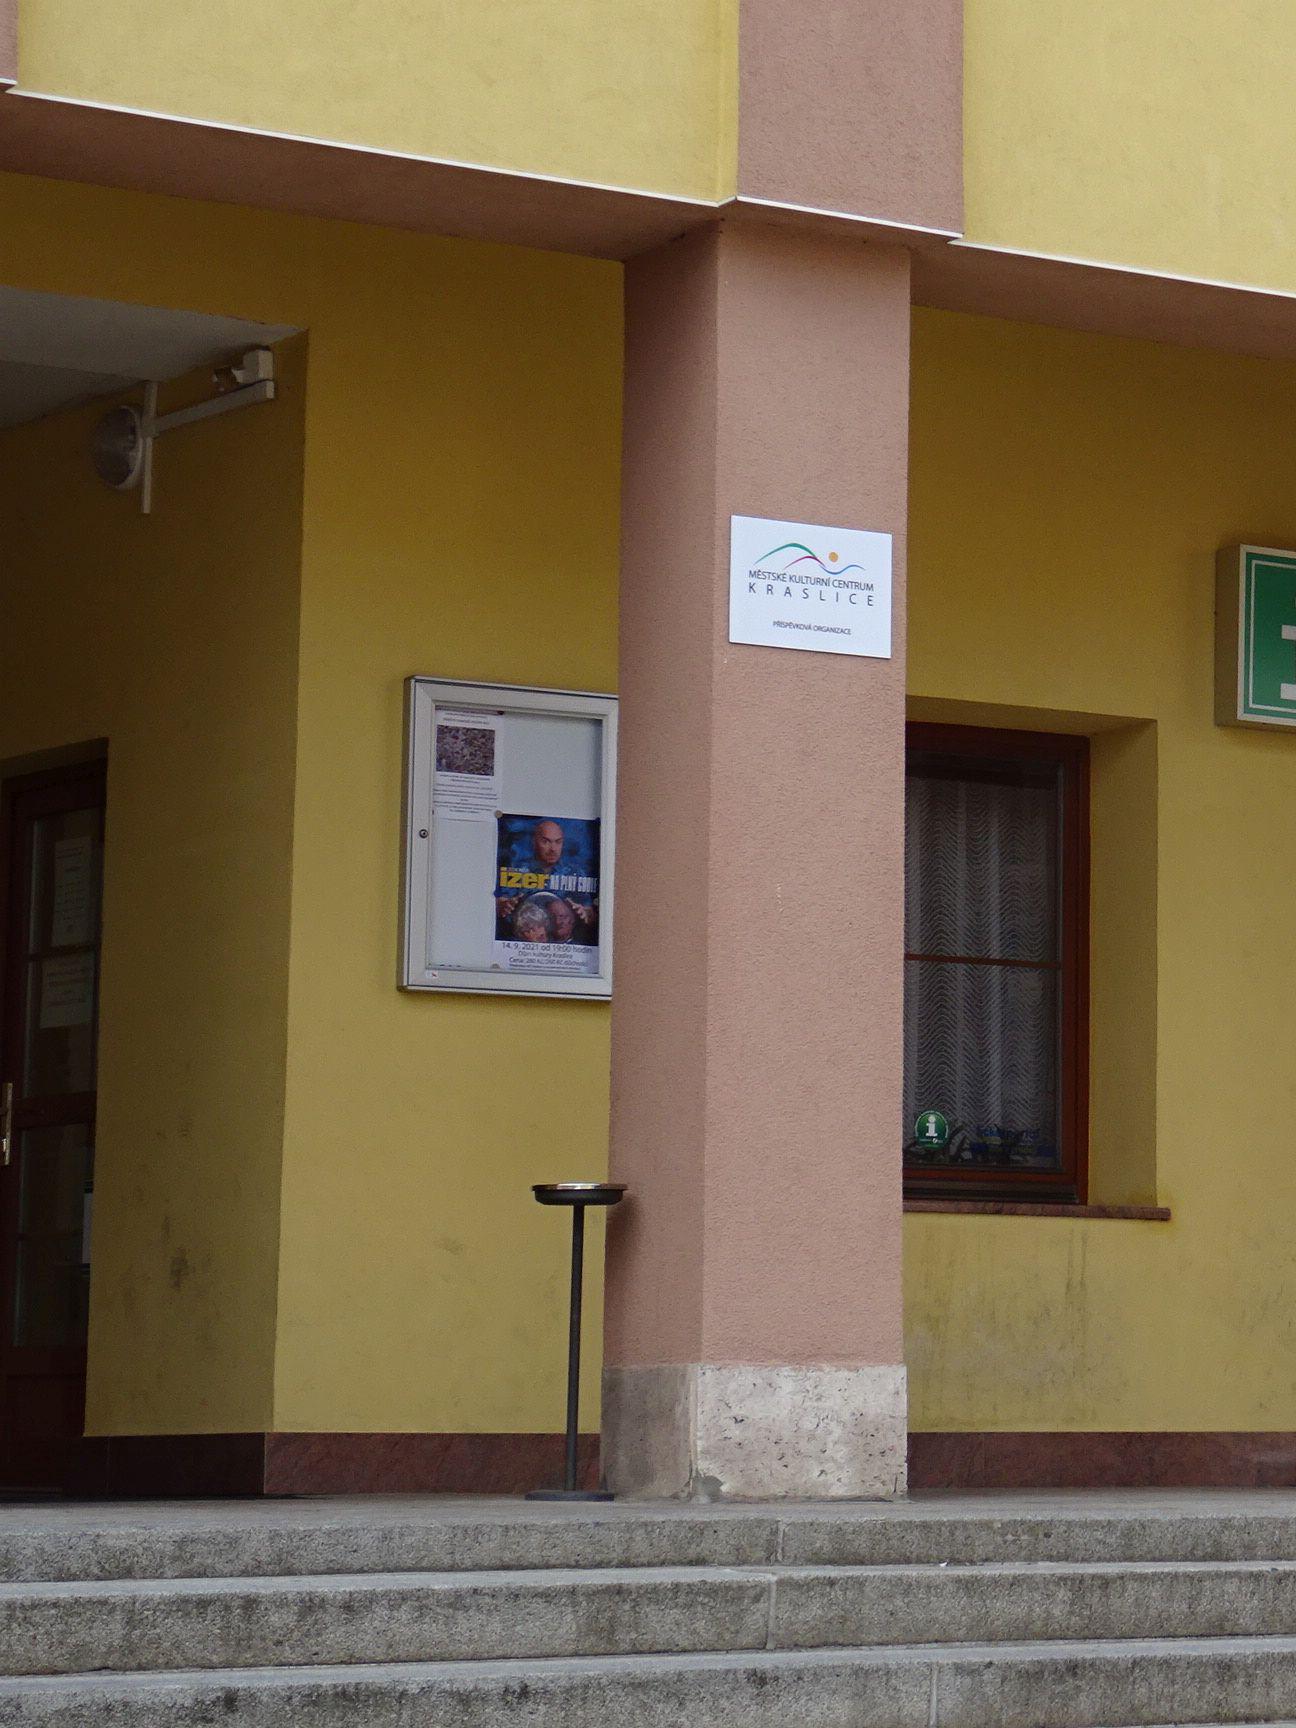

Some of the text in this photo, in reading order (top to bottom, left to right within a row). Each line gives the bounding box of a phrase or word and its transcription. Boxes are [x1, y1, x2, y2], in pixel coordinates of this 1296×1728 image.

[748, 569, 875, 592] MĚSTSKÉ KULTURNÍ CENTRUM
[748, 581, 875, 606] KRASLICE
[812, 624, 852, 636] ORGANIZACE
[522, 943, 539, 951] 2021
